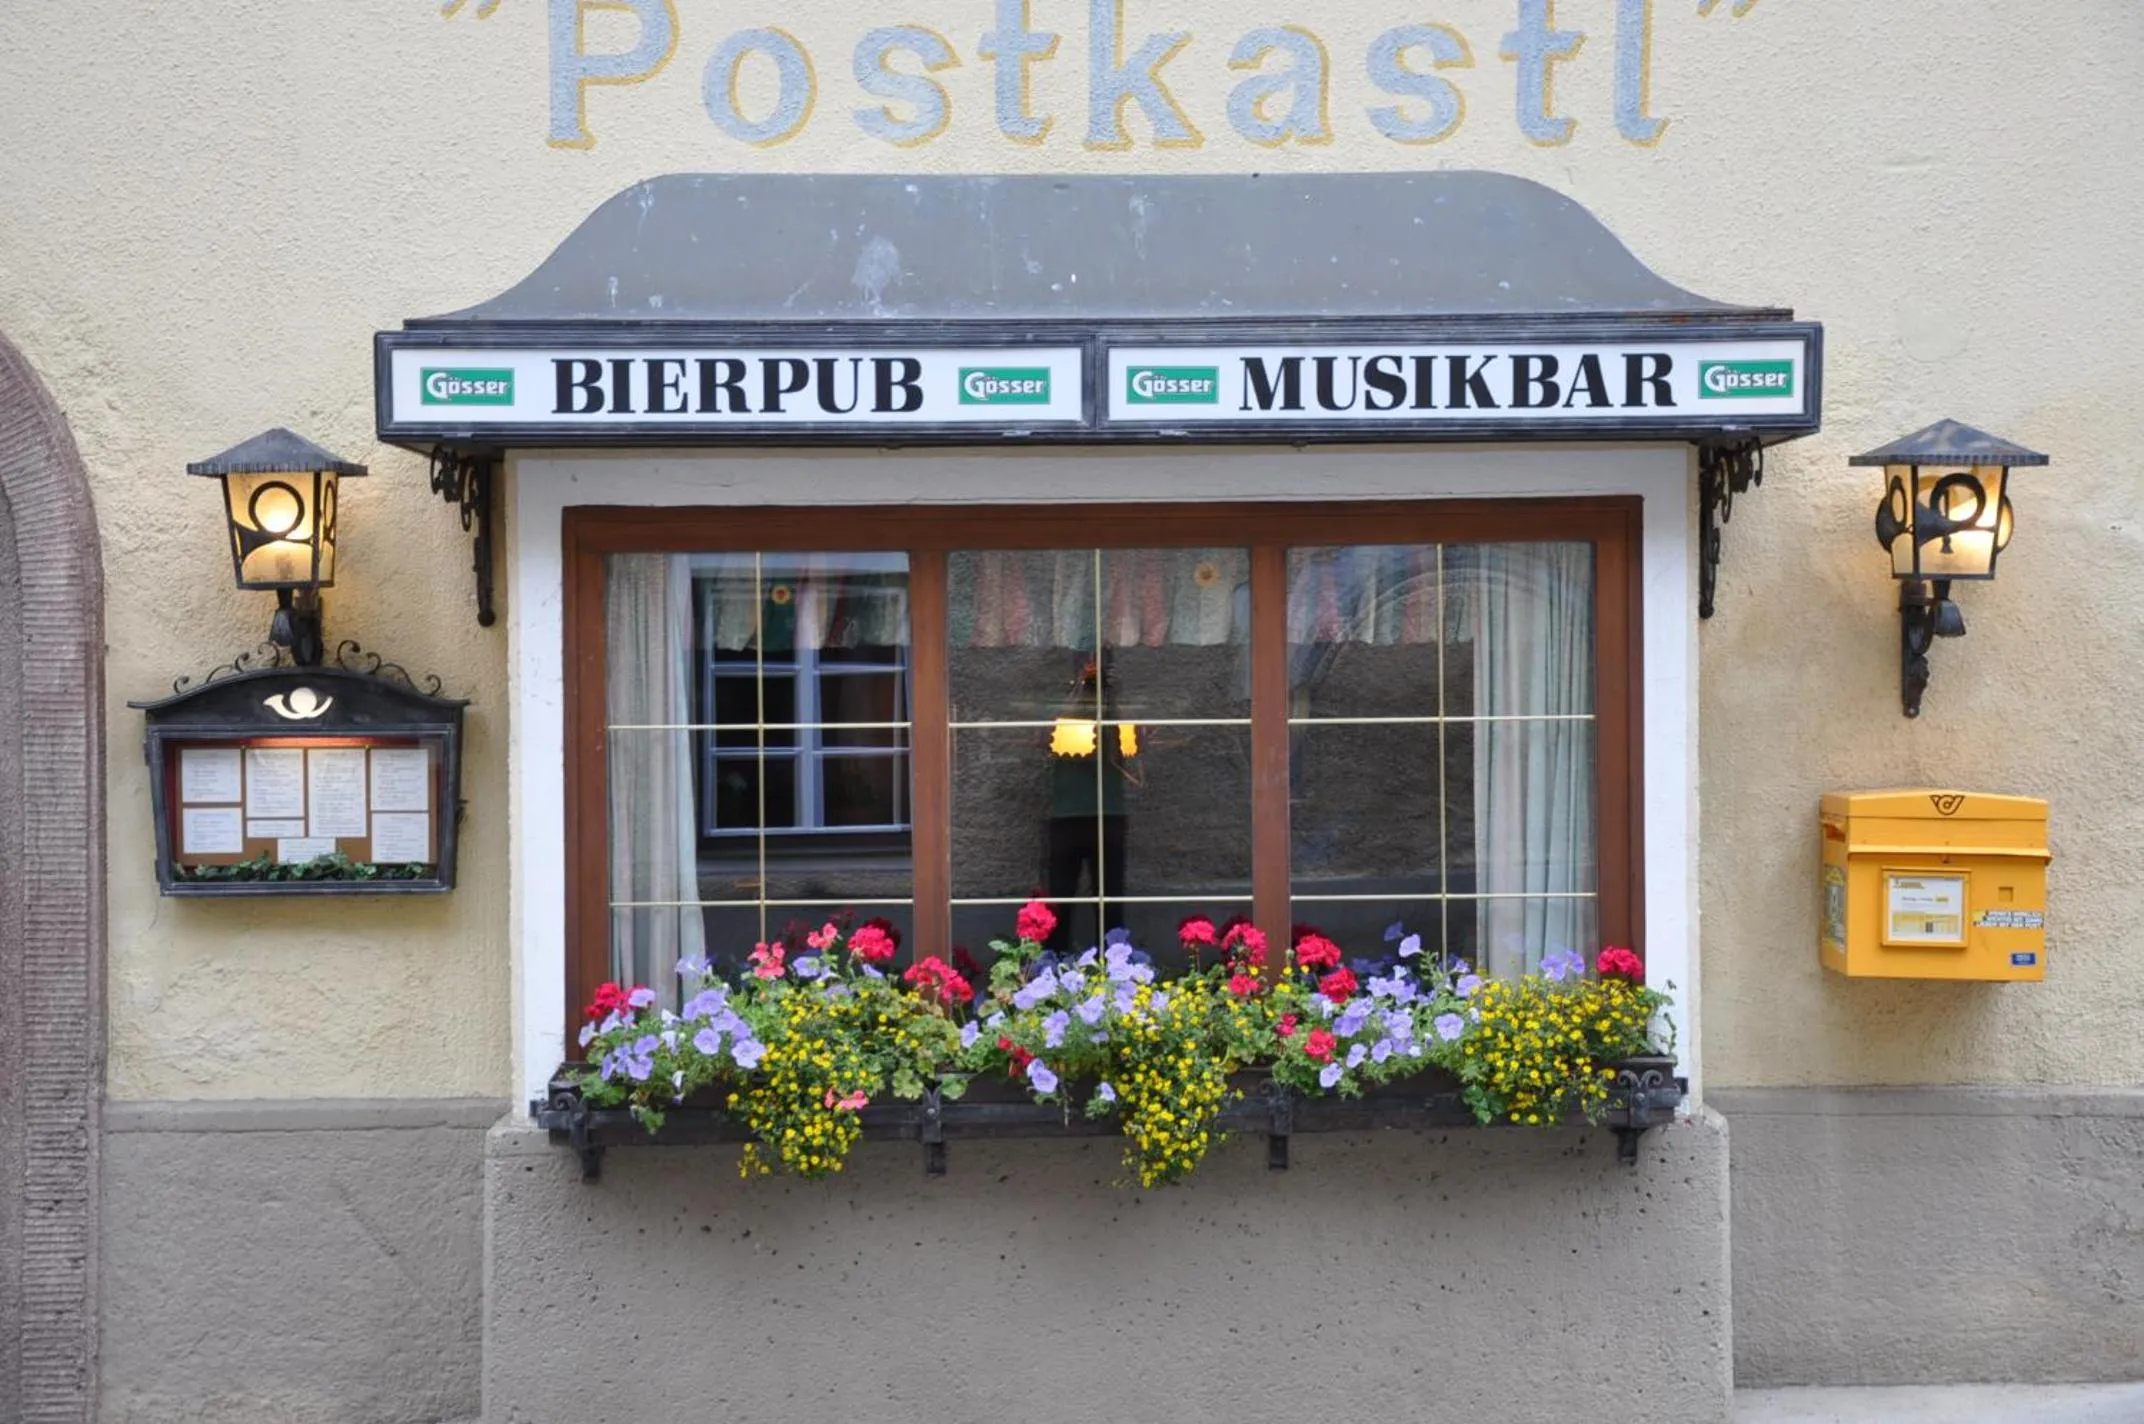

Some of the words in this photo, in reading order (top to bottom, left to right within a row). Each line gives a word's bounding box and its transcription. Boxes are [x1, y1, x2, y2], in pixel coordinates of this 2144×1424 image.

[426, 372, 509, 399] Gösser
[551, 357, 924, 414] BIERPUB
[964, 371, 1046, 399] Gösser
[1132, 371, 1214, 397] Gösser
[1239, 352, 1677, 412] MUSIKBAR
[1704, 365, 1788, 392] Gösser
